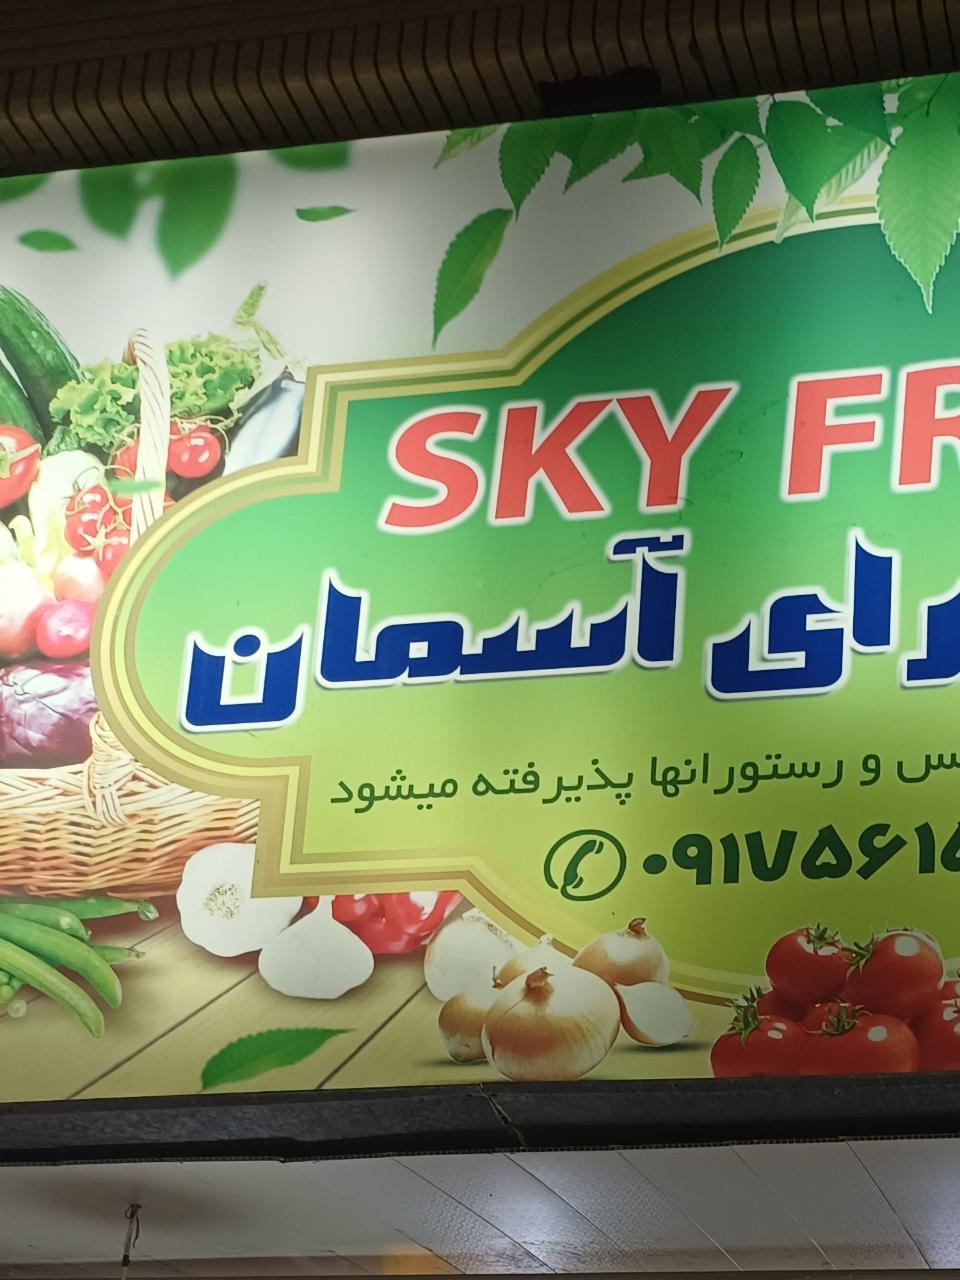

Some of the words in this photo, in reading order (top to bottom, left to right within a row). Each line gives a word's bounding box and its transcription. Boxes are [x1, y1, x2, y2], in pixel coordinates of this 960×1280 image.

[382, 384, 736, 532] SKY
[182, 532, 687, 729] آسمان
[330, 768, 459, 815] میشود
[471, 757, 635, 806] پذیرفته
[649, 751, 845, 797] رستورانها
[859, 752, 882, 786] و
